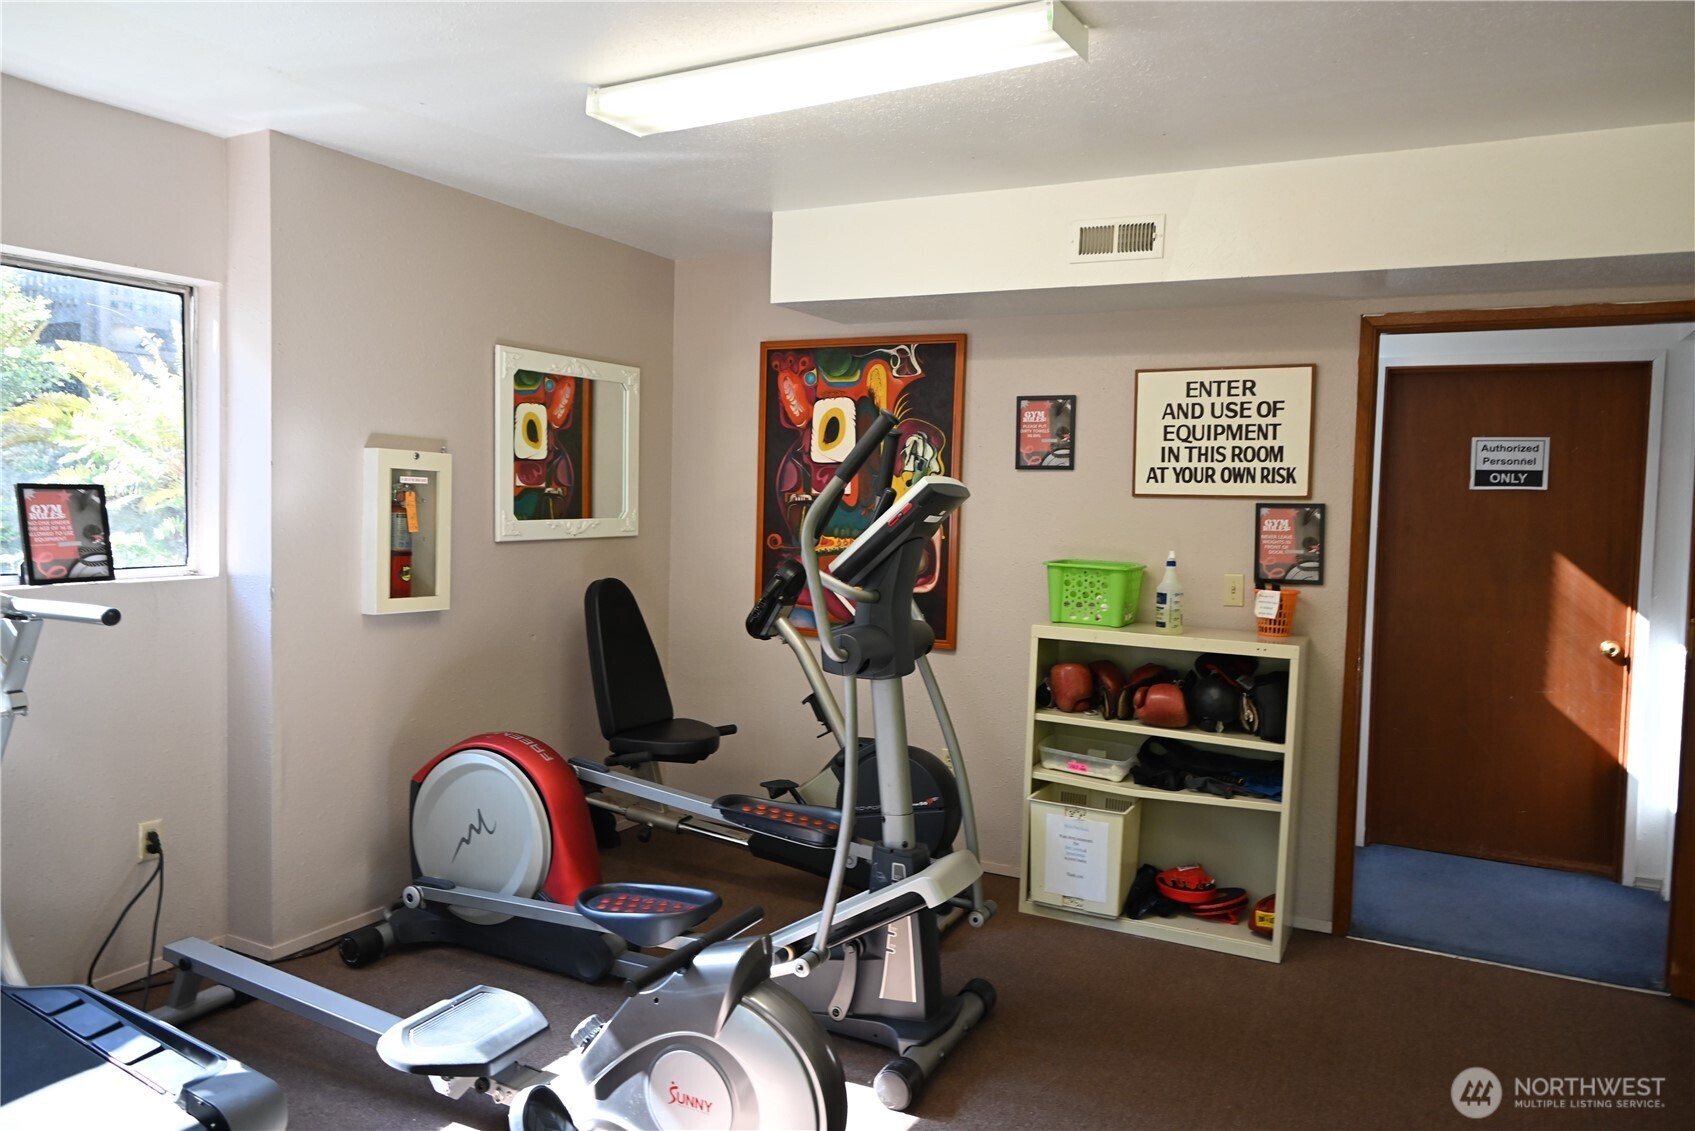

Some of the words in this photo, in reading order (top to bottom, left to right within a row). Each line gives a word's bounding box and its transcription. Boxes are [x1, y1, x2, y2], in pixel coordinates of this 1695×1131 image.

[1185, 379, 1257, 398] ENTER
[1161, 403, 1205, 420] AND
[1210, 401, 1253, 420] USE
[1256, 400, 1286, 418] OF
[1163, 423, 1282, 443] EQUIPMENT
[1160, 446, 1181, 463] IN
[1184, 446, 1227, 463] THIS
[1231, 445, 1284, 463] ROOM
[1481, 444, 1540, 453] Authorized
[1482, 457, 1537, 466] Personnel
[1146, 466, 1169, 484] AT
[1172, 466, 1216, 484] YOUR
[1220, 466, 1257, 484] OWN
[1260, 466, 1297, 484] RISK
[1489, 472, 1528, 484] ONLY
[30, 504, 62, 514] GYM
[1264, 519, 1289, 527] GYM
[668, 1081, 713, 1112] SUNNY
